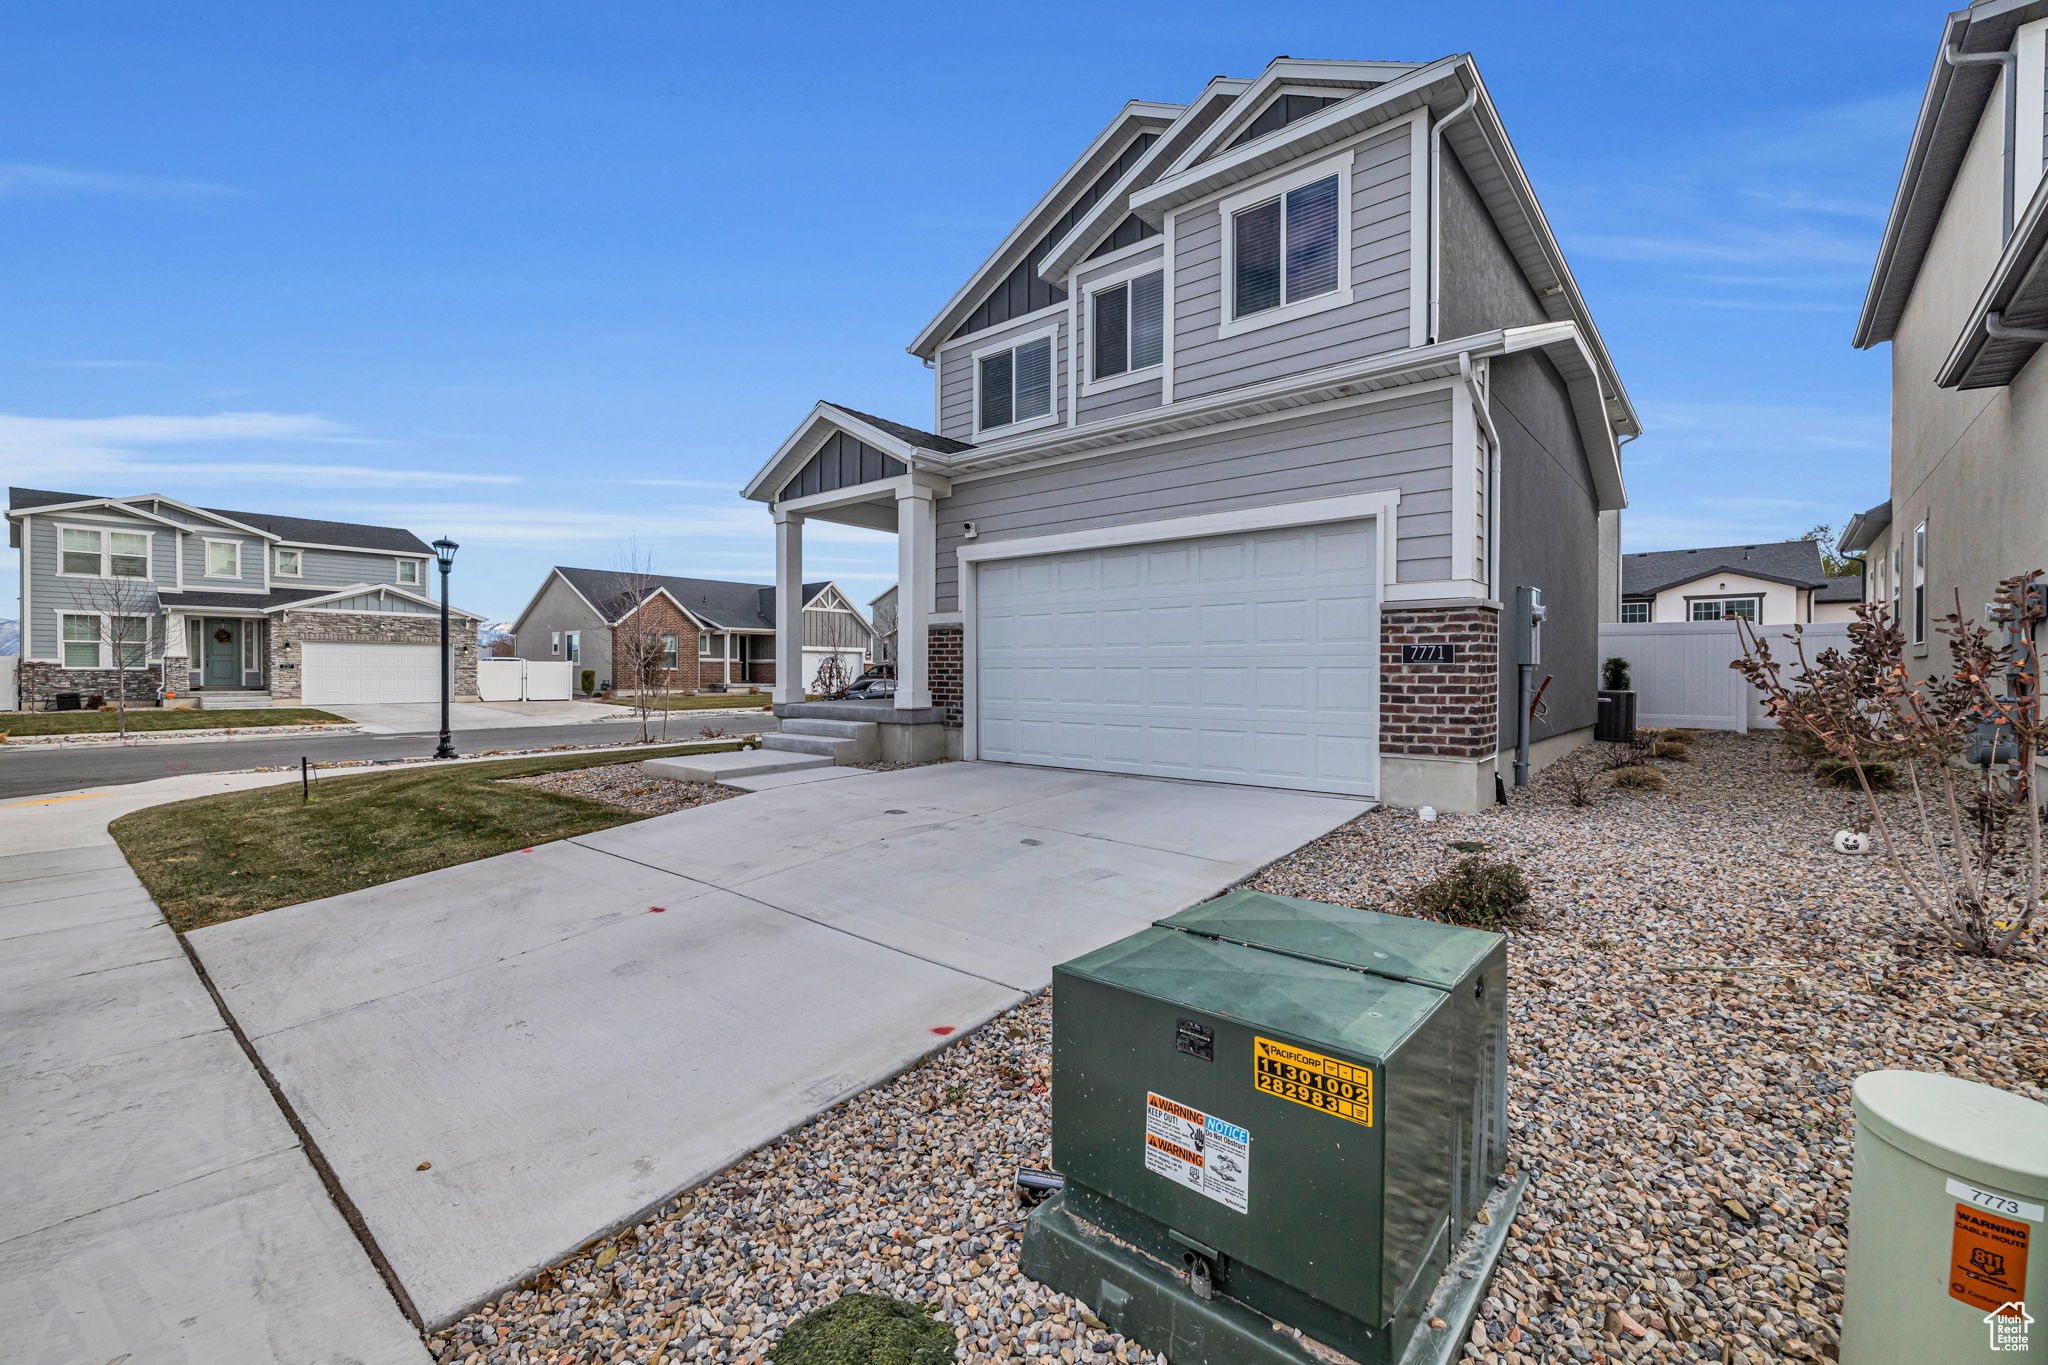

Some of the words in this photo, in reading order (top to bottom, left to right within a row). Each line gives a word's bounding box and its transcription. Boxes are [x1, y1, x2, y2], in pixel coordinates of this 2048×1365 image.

[1410, 645, 1445, 660] 7771
[1260, 1075, 1339, 1112] 282983
[1147, 1106, 1163, 1119] KEEP
[1163, 1112, 1178, 1126] OUT!
[1158, 1097, 1204, 1126] WARNING
[1205, 1129, 1213, 1138] Do
[1213, 1132, 1223, 1142] Not
[1223, 1136, 1246, 1151] Obstruct
[1207, 1118, 1247, 1143] NOTICE
[1157, 1137, 1203, 1167] WARNING
[1970, 1188, 2019, 1214] 7773
[1955, 1221, 1989, 1239] CABLE
[1991, 1233, 2027, 1249] ROUTE
[1957, 1210, 2027, 1240] WARNING
